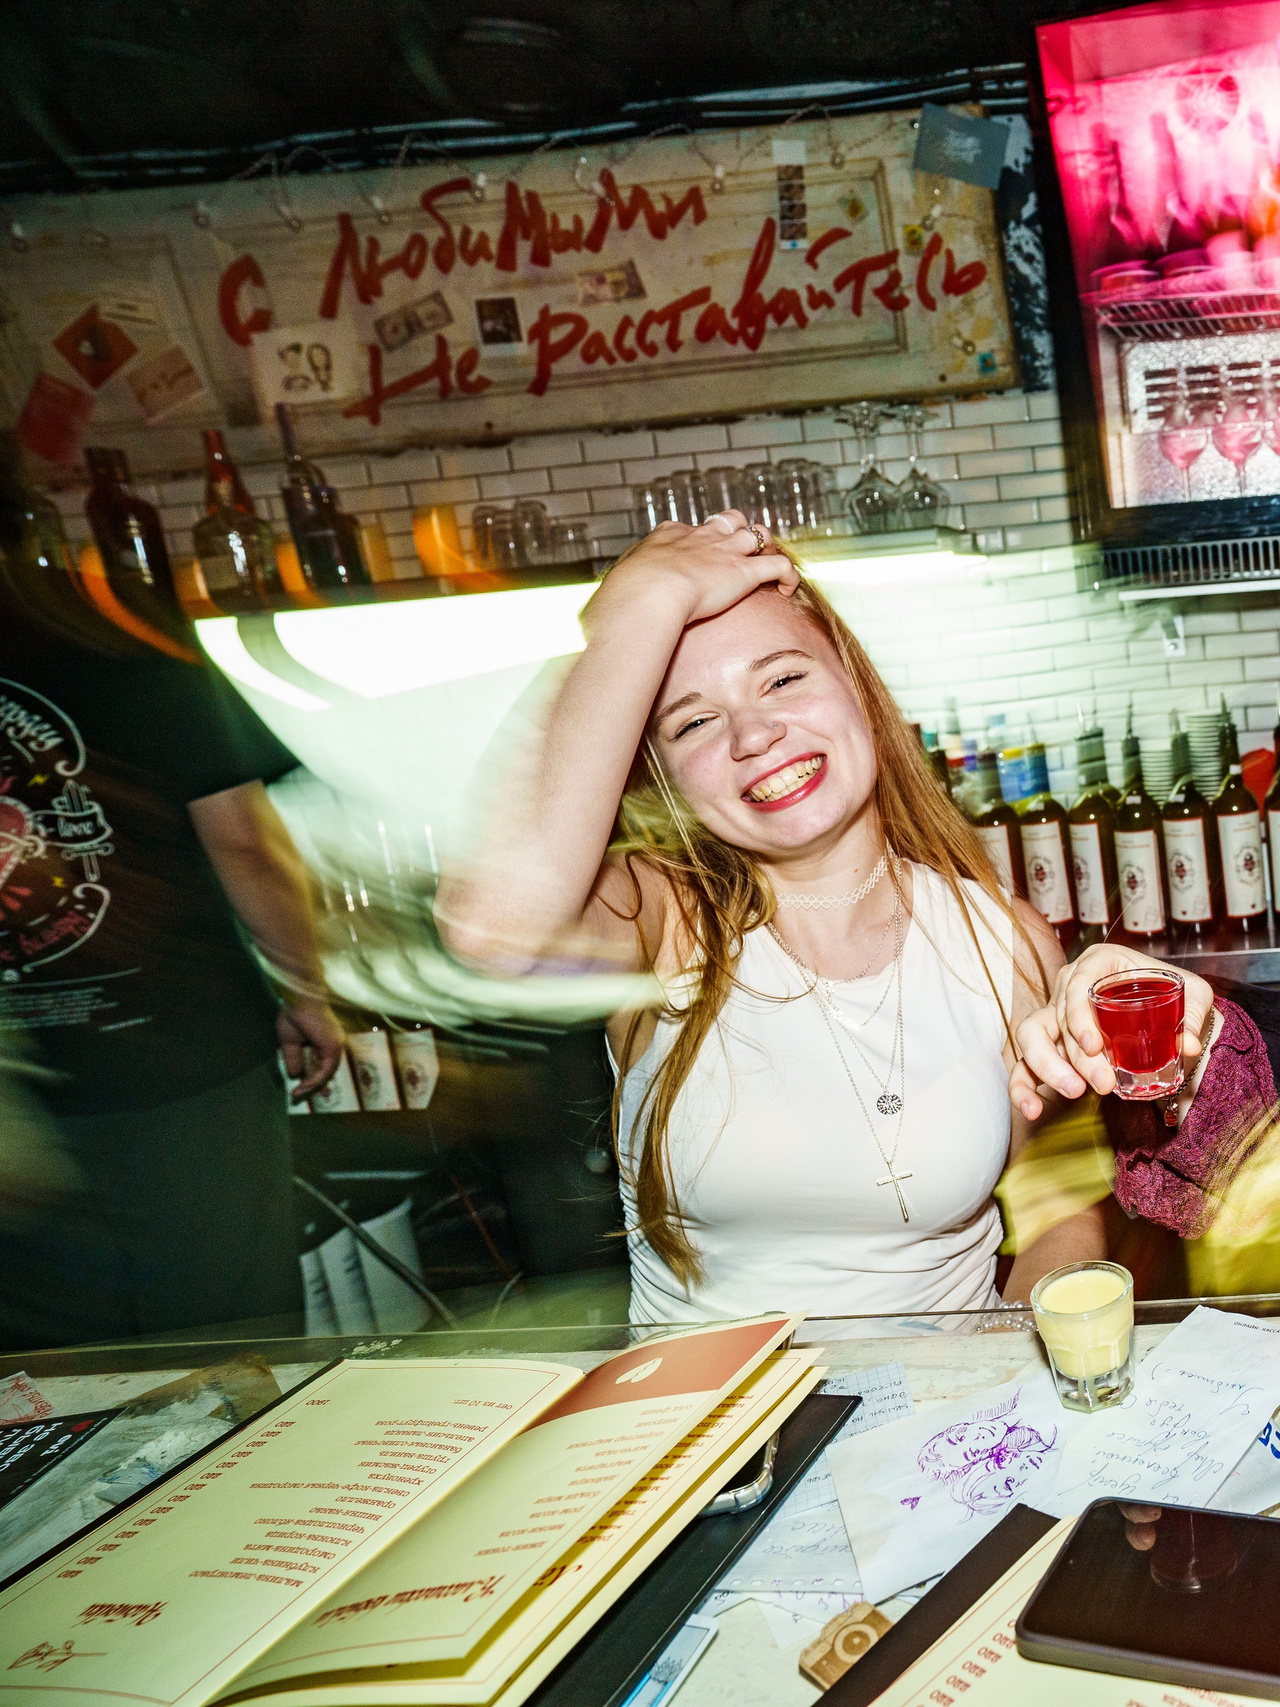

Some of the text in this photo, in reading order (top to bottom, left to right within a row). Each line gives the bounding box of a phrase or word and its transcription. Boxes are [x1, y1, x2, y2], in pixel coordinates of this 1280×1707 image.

[342, 334, 492, 426] Не
[471, 1400, 482, 1408] 10
[977, 1646, 1002, 1664] 220
[962, 1661, 987, 1678] 220
[945, 1674, 972, 1692] 220
